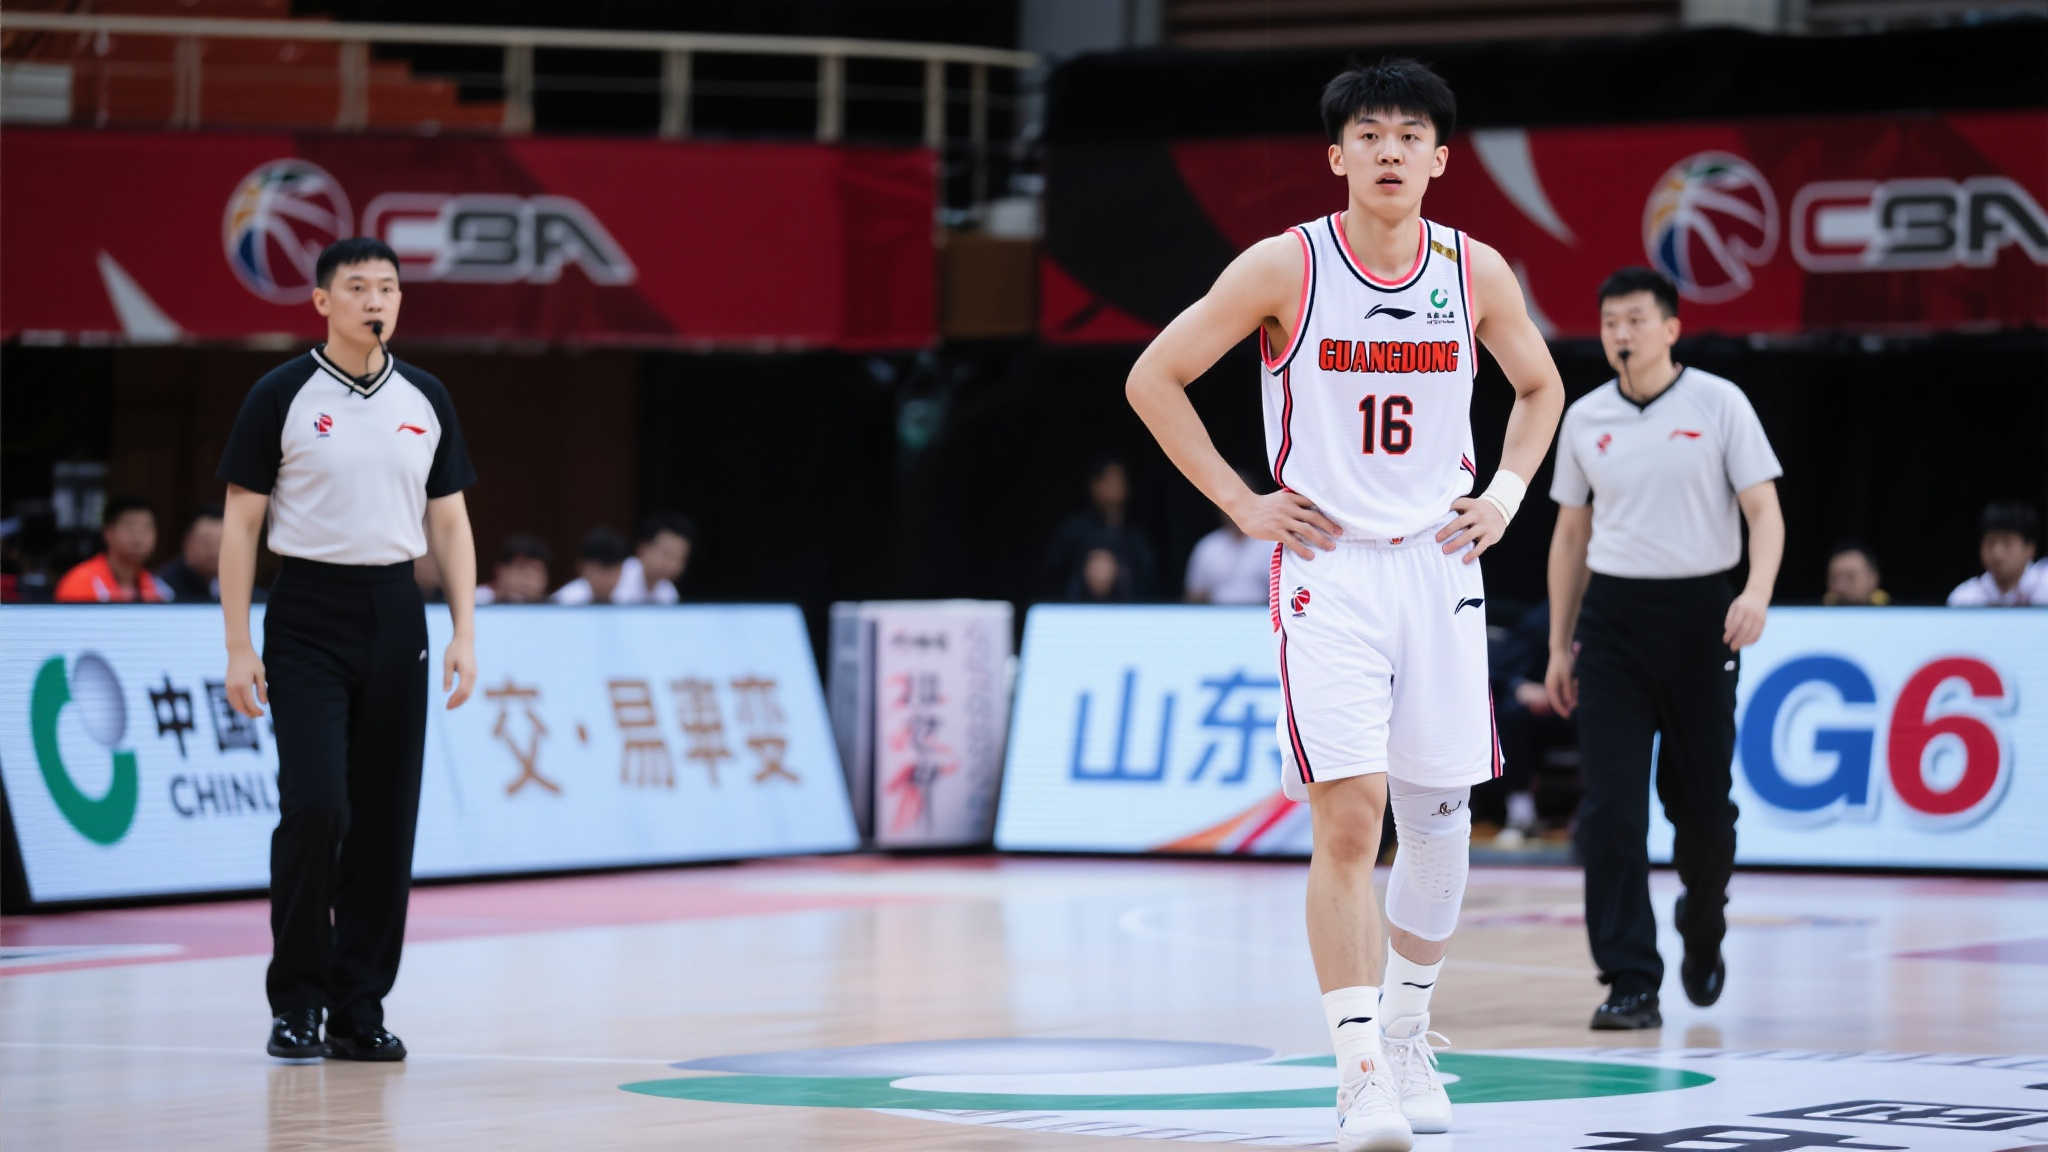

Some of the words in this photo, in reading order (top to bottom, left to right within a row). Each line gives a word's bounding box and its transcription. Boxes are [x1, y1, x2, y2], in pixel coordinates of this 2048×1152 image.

[361, 192, 638, 286] CBA
[1790, 176, 2048, 273] CBA
[1319, 338, 1459, 373] GUANGDONG
[1358, 394, 1413, 455] 16
[149, 672, 275, 757] 中国
[1066, 667, 1283, 786] 山东
[1739, 653, 2012, 822] G6
